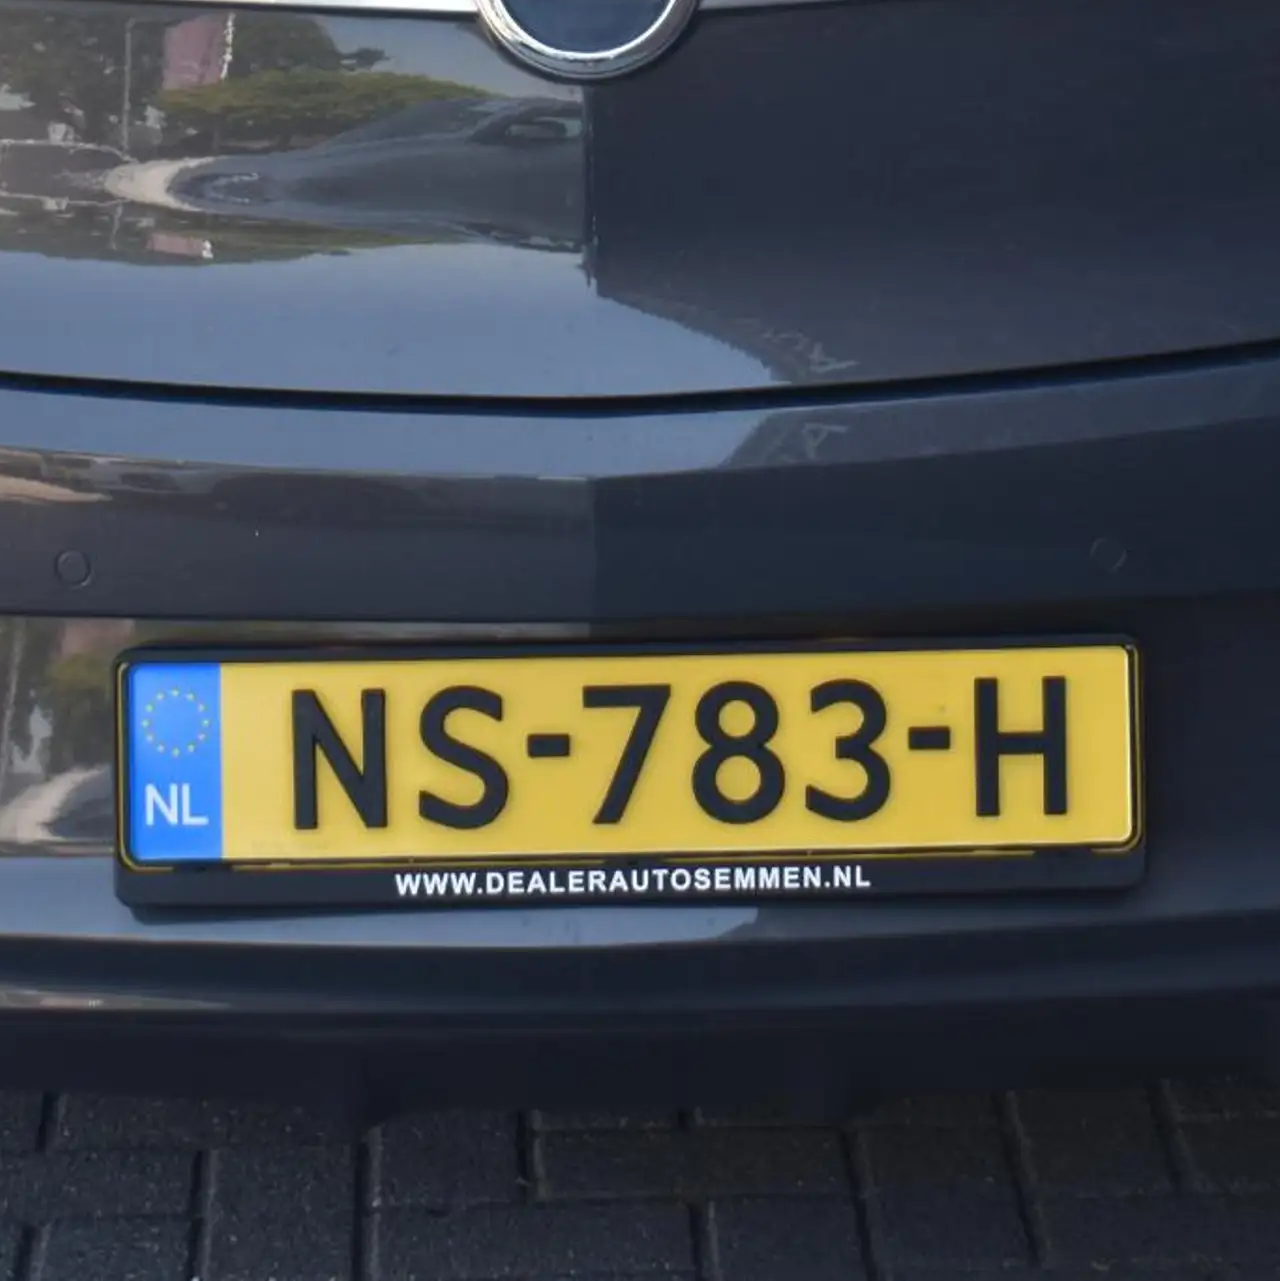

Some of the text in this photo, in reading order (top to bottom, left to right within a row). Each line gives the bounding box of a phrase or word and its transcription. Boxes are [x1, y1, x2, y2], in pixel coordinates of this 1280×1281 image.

[291, 676, 1069, 831] NS-783-H
[145, 783, 209, 826] NL
[394, 865, 872, 897] WWW.DEALERAUTOSEMMEN.NL
